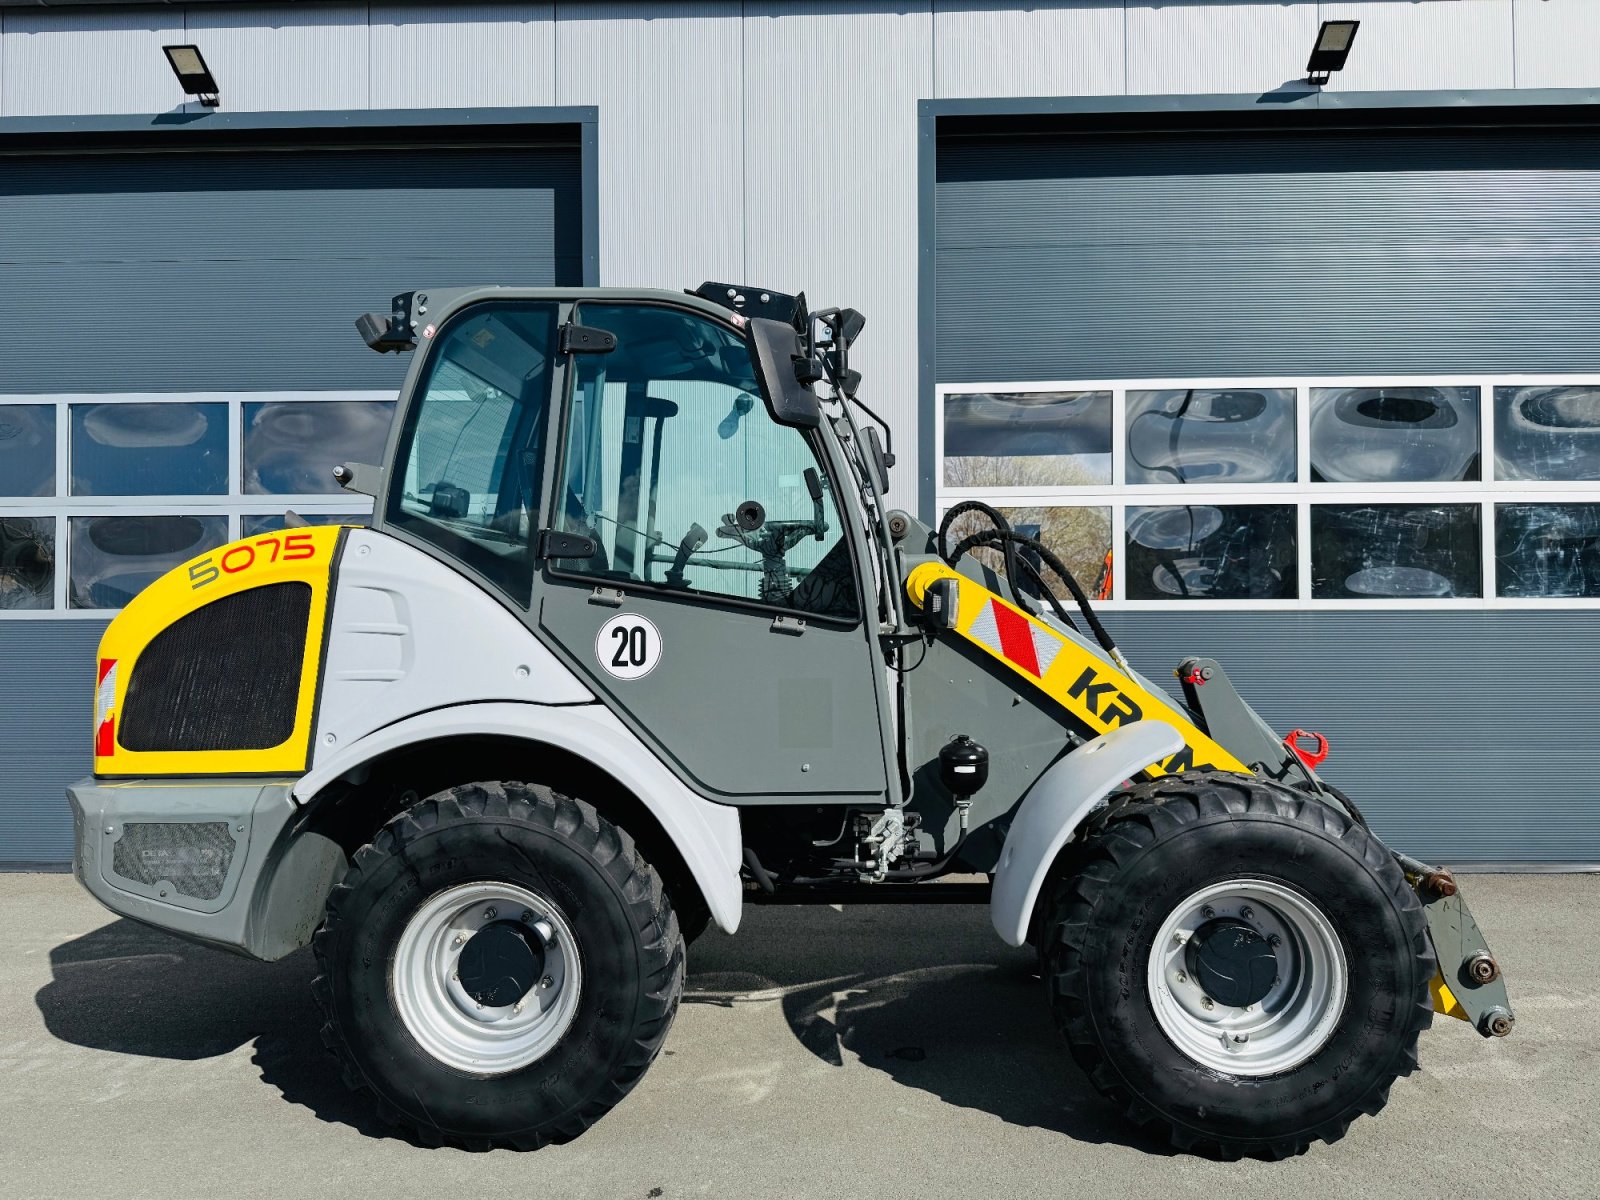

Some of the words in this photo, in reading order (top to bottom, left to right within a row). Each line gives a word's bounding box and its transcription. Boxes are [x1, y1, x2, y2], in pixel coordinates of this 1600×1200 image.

[188, 533, 316, 591] 5075
[611, 625, 647, 667] 20
[1066, 665, 1218, 774] KRM
